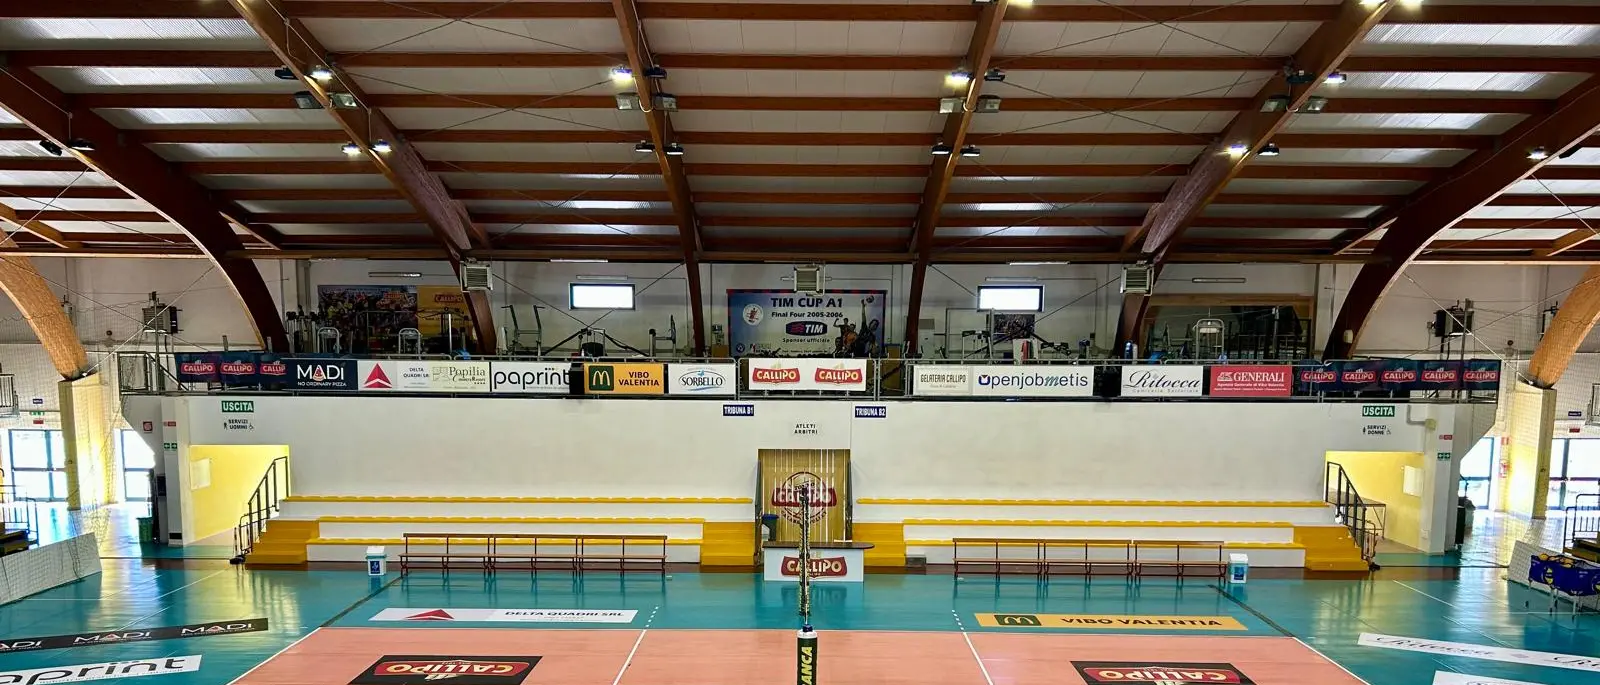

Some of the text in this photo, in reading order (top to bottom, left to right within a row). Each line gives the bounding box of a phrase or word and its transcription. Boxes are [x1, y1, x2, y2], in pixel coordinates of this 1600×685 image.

[770, 298, 843, 307] TIM CUP A1
[805, 324, 824, 333] TIM
[494, 368, 570, 390] paprint
[756, 370, 797, 381] CALLIPO
[818, 370, 859, 381] CALLIPO
[920, 374, 966, 383] GELATERIA CALLIPO
[1233, 372, 1284, 381] GENERALI
[681, 377, 723, 386] SORBELLO
[223, 401, 253, 411] USCITA
[724, 406, 754, 415] TRIBUNA B1
[856, 408, 886, 416] TRIBUNA B2
[1363, 406, 1394, 416] USCITA
[182, 623, 252, 634] MADI
[74, 632, 152, 642] MADI
[386, 664, 514, 673] CALLIPO
[1099, 670, 1227, 681] CALLIPO
